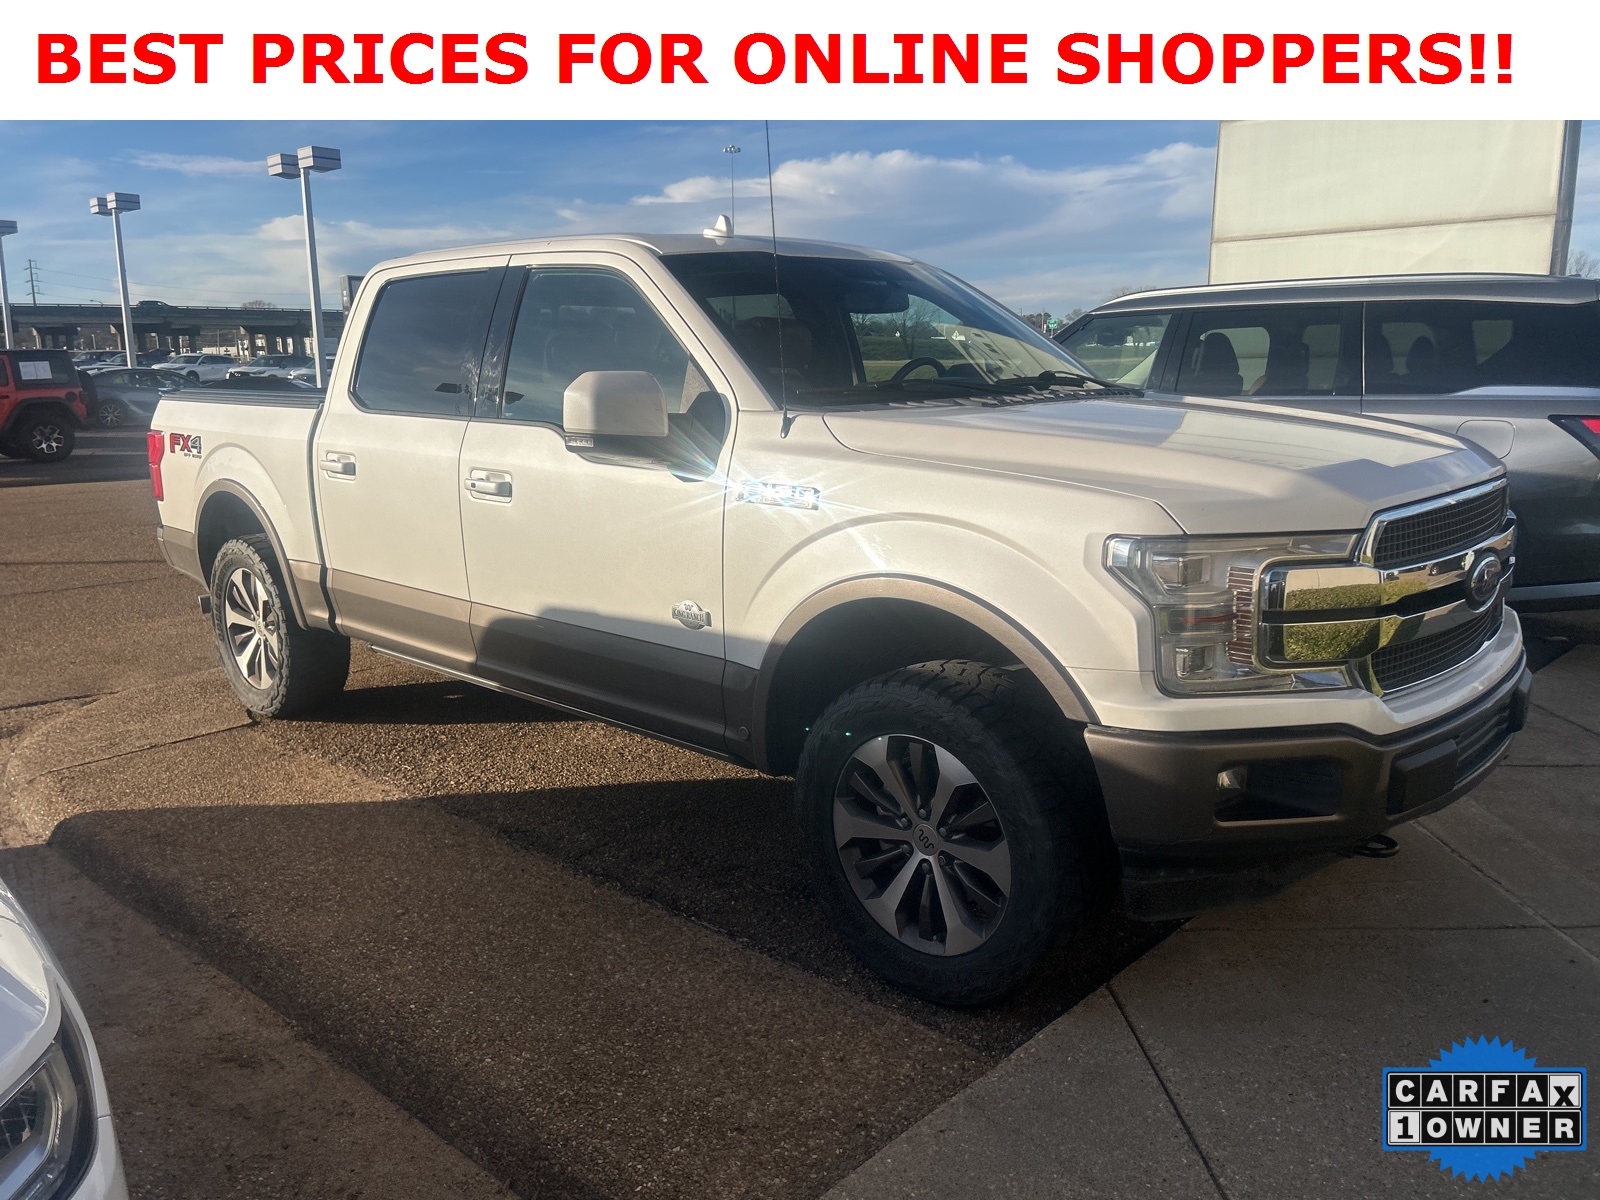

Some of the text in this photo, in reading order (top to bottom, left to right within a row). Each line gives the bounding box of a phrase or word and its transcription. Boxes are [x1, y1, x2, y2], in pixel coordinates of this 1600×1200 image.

[169, 432, 202, 454] FX4
[673, 608, 704, 622] KING RANCH
